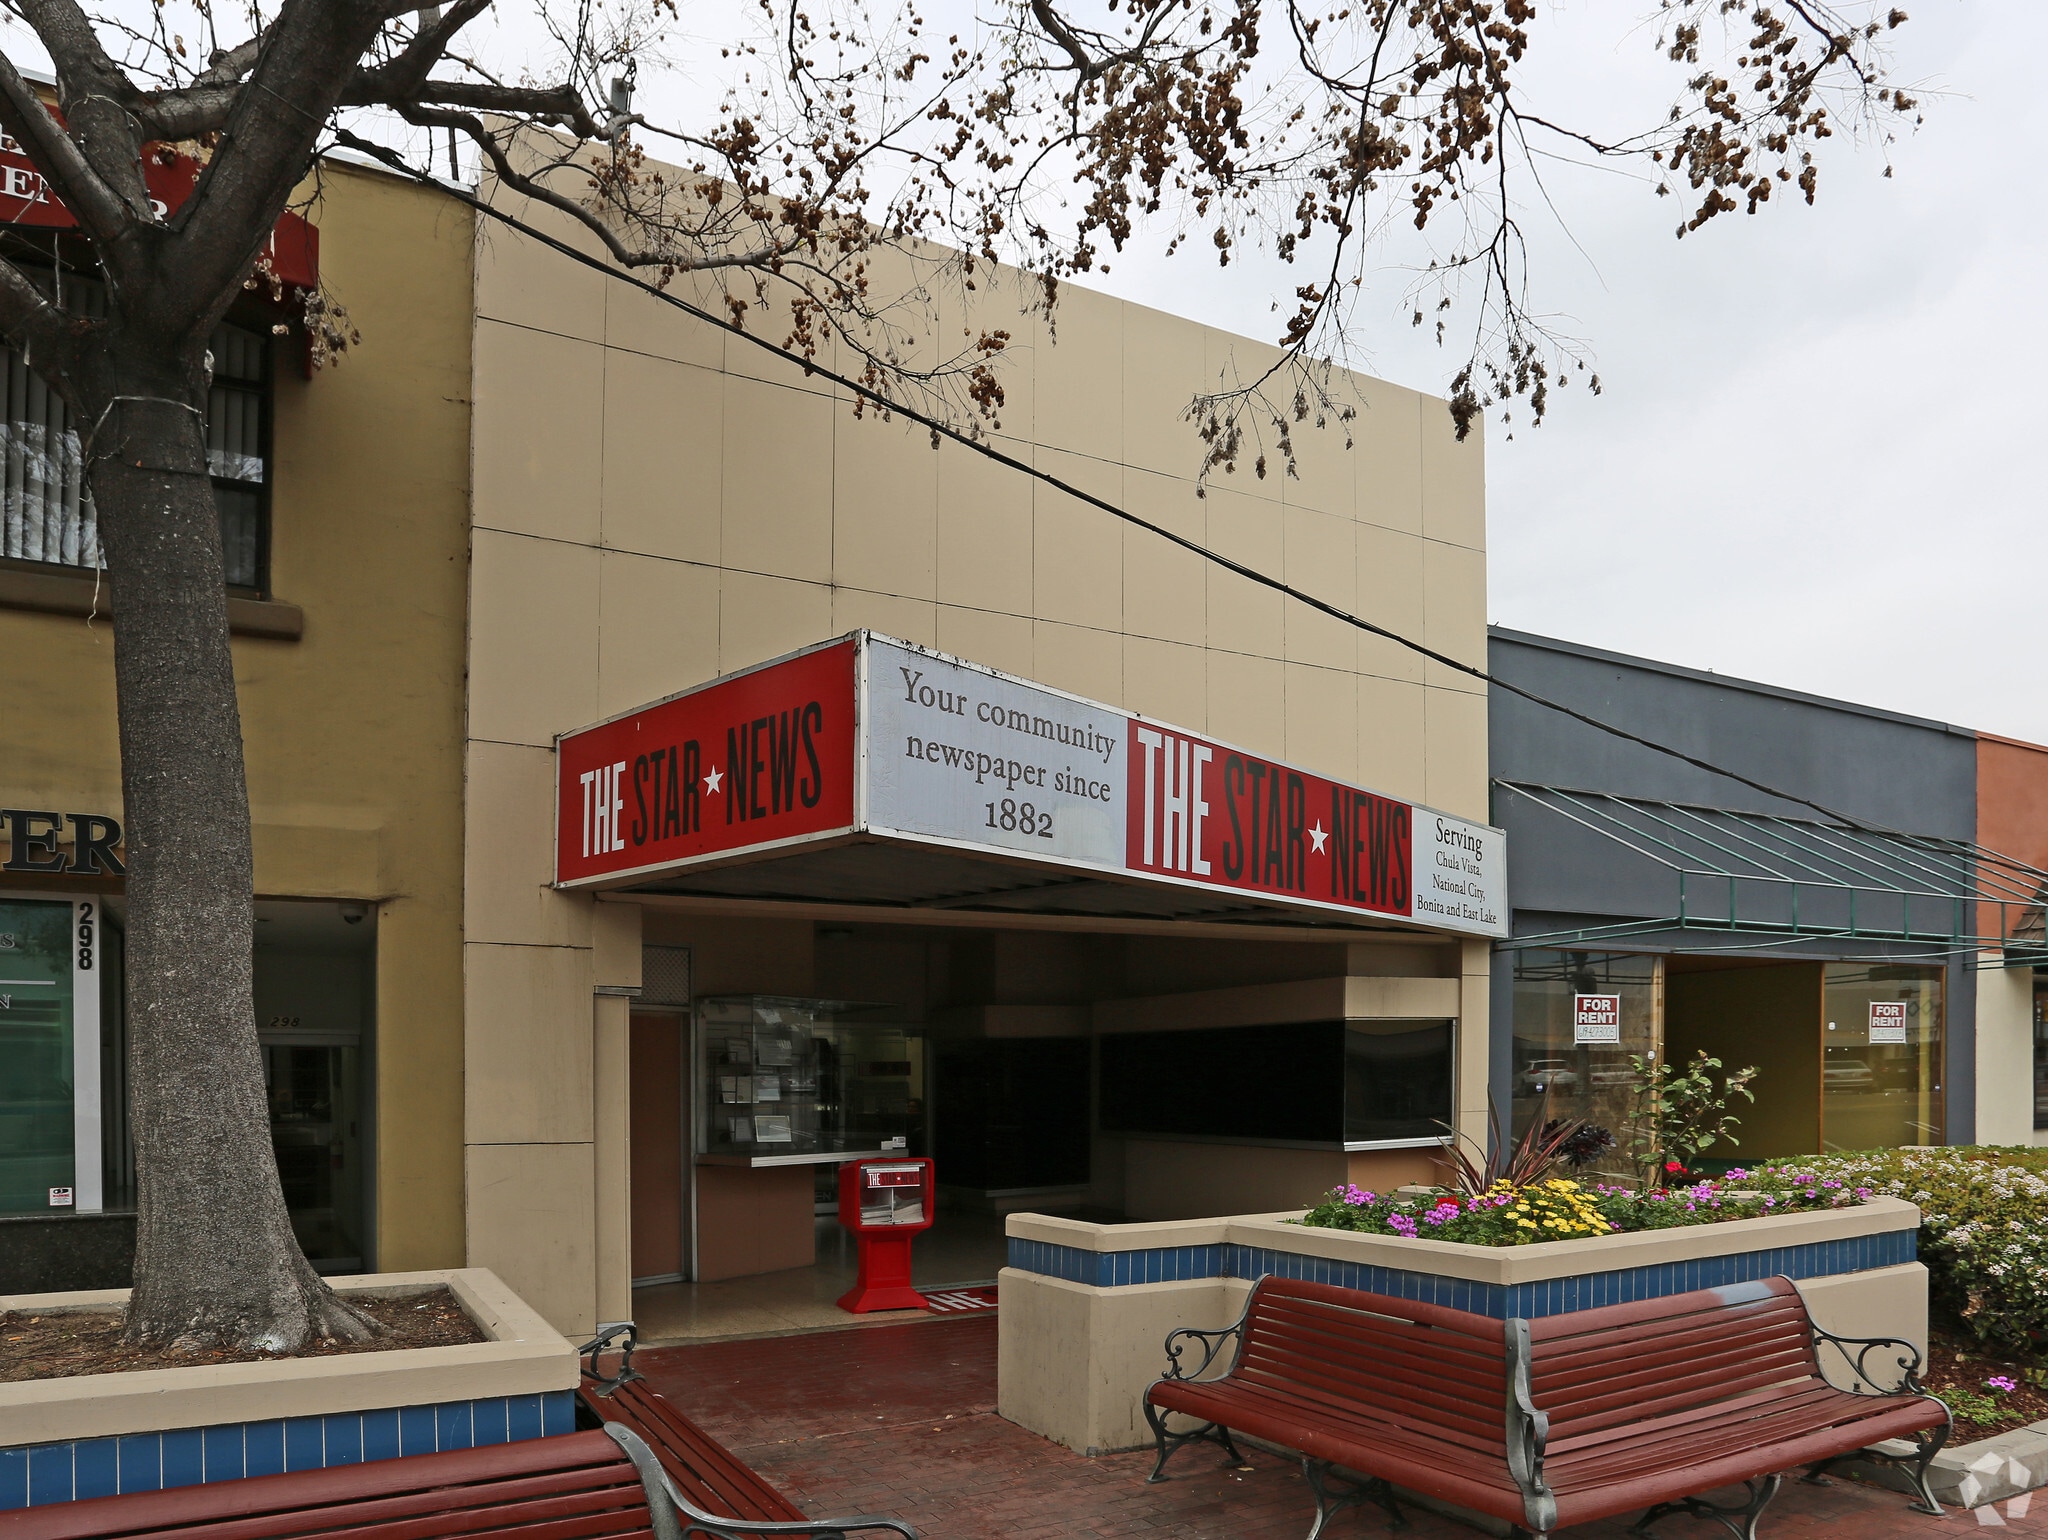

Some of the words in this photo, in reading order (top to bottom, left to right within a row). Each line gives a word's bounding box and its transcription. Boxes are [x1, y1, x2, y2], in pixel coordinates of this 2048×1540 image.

[899, 666, 967, 716] Your
[976, 700, 1117, 764] community
[580, 760, 626, 858] THE
[632, 738, 701, 847] STAR
[726, 701, 822, 825] NEWS
[906, 735, 1046, 791] newspaper
[1054, 766, 1111, 802] since
[985, 798, 1053, 838] 1882
[1137, 726, 1213, 876] THE
[1223, 754, 1306, 892] STAR
[1331, 786, 1407, 910] NEWS
[0, 808, 126, 875] ER
[1436, 817, 1483, 861] Serving
[1435, 850, 1460, 871] Chula
[1461, 857, 1482, 878] Vista,
[1432, 873, 1466, 895] National
[1468, 882, 1486, 904] City,
[1417, 894, 1444, 914] Bonita
[1447, 902, 1461, 917] and
[1463, 904, 1478, 920] East
[1480, 908, 1497, 924] Lake
[78, 902, 93, 971] 298
[1578, 1011, 1616, 1024] RENT
[1583, 999, 1611, 1011] FOR
[1876, 1006, 1899, 1016] FOR
[270, 1016, 301, 1027] 298
[1872, 1016, 1903, 1027] RENT
[868, 1173, 881, 1186] THE
